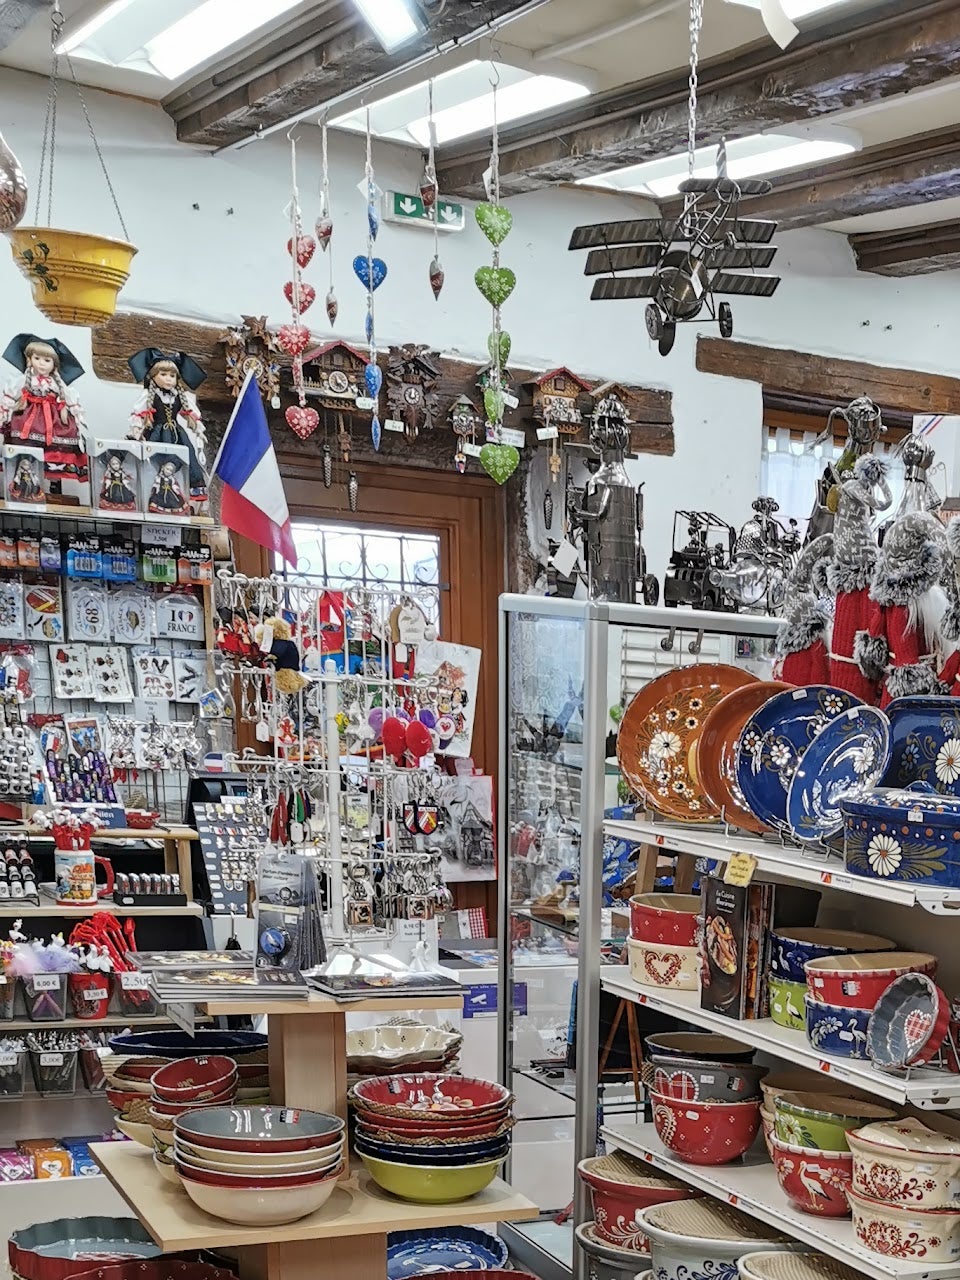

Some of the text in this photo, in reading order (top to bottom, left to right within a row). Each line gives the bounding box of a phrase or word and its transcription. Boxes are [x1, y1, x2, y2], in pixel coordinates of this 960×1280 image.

[146, 527, 177, 536] STICKER
[171, 610, 176, 621] I
[167, 622, 197, 634] FRANCE
